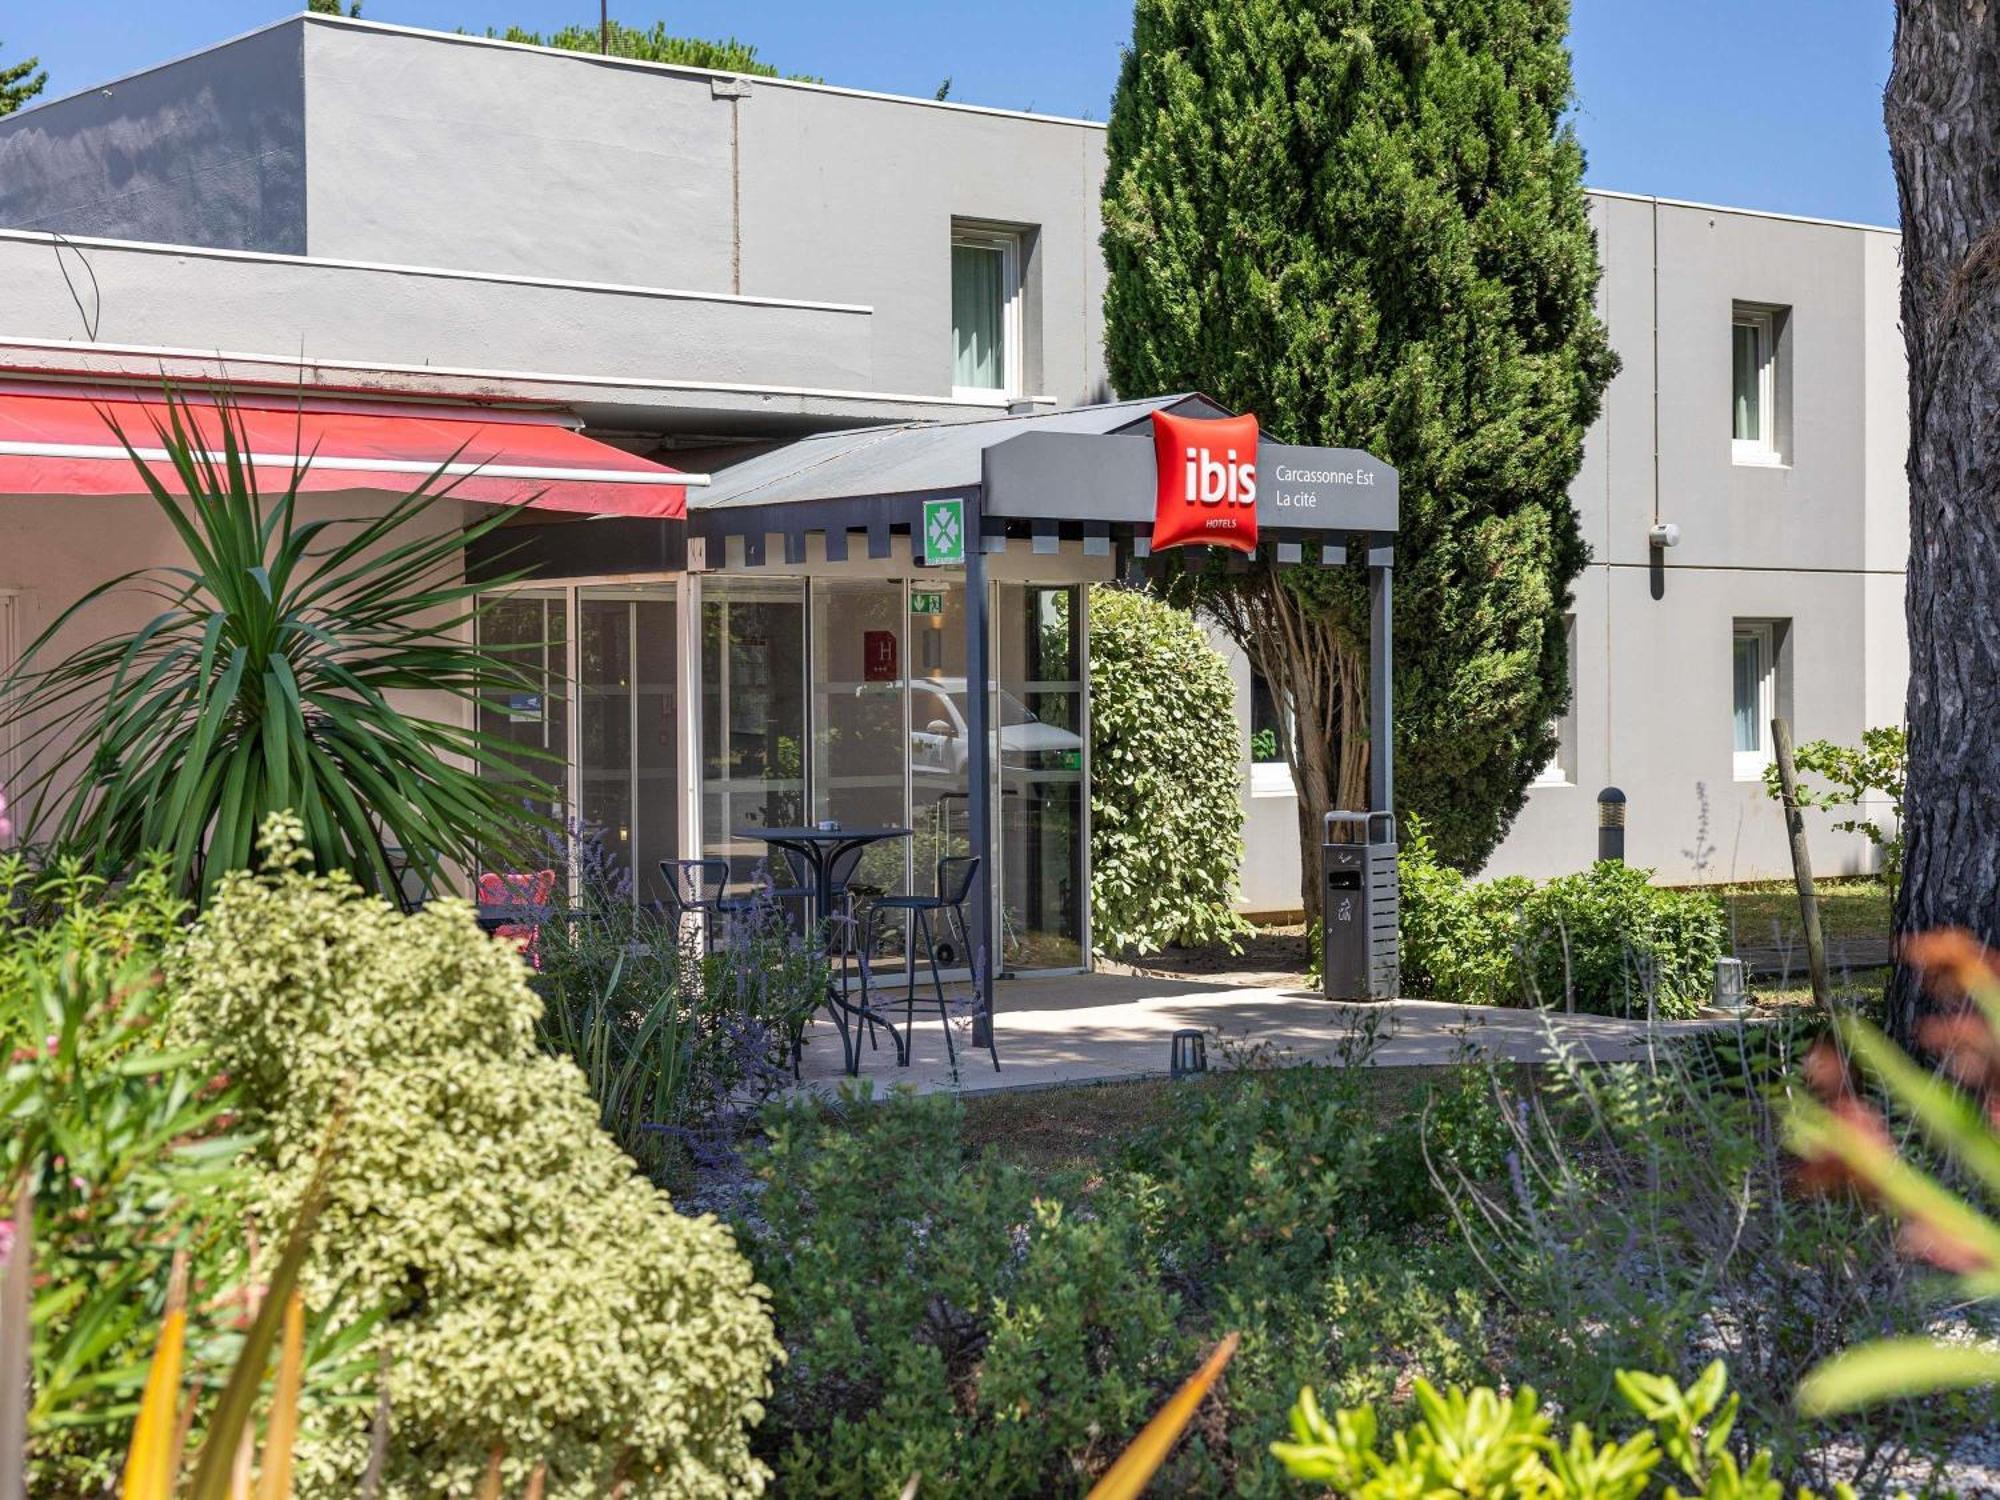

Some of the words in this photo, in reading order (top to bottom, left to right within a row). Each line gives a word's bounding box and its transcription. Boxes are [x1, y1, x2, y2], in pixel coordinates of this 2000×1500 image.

[1186, 448, 1256, 504] ibis
[1275, 464, 1354, 485] Carcassonne
[1356, 468, 1375, 486] Est
[1276, 489, 1291, 507] La
[1294, 491, 1318, 508] cité
[1206, 519, 1237, 529] HOTELS
[880, 641, 892, 660] H
